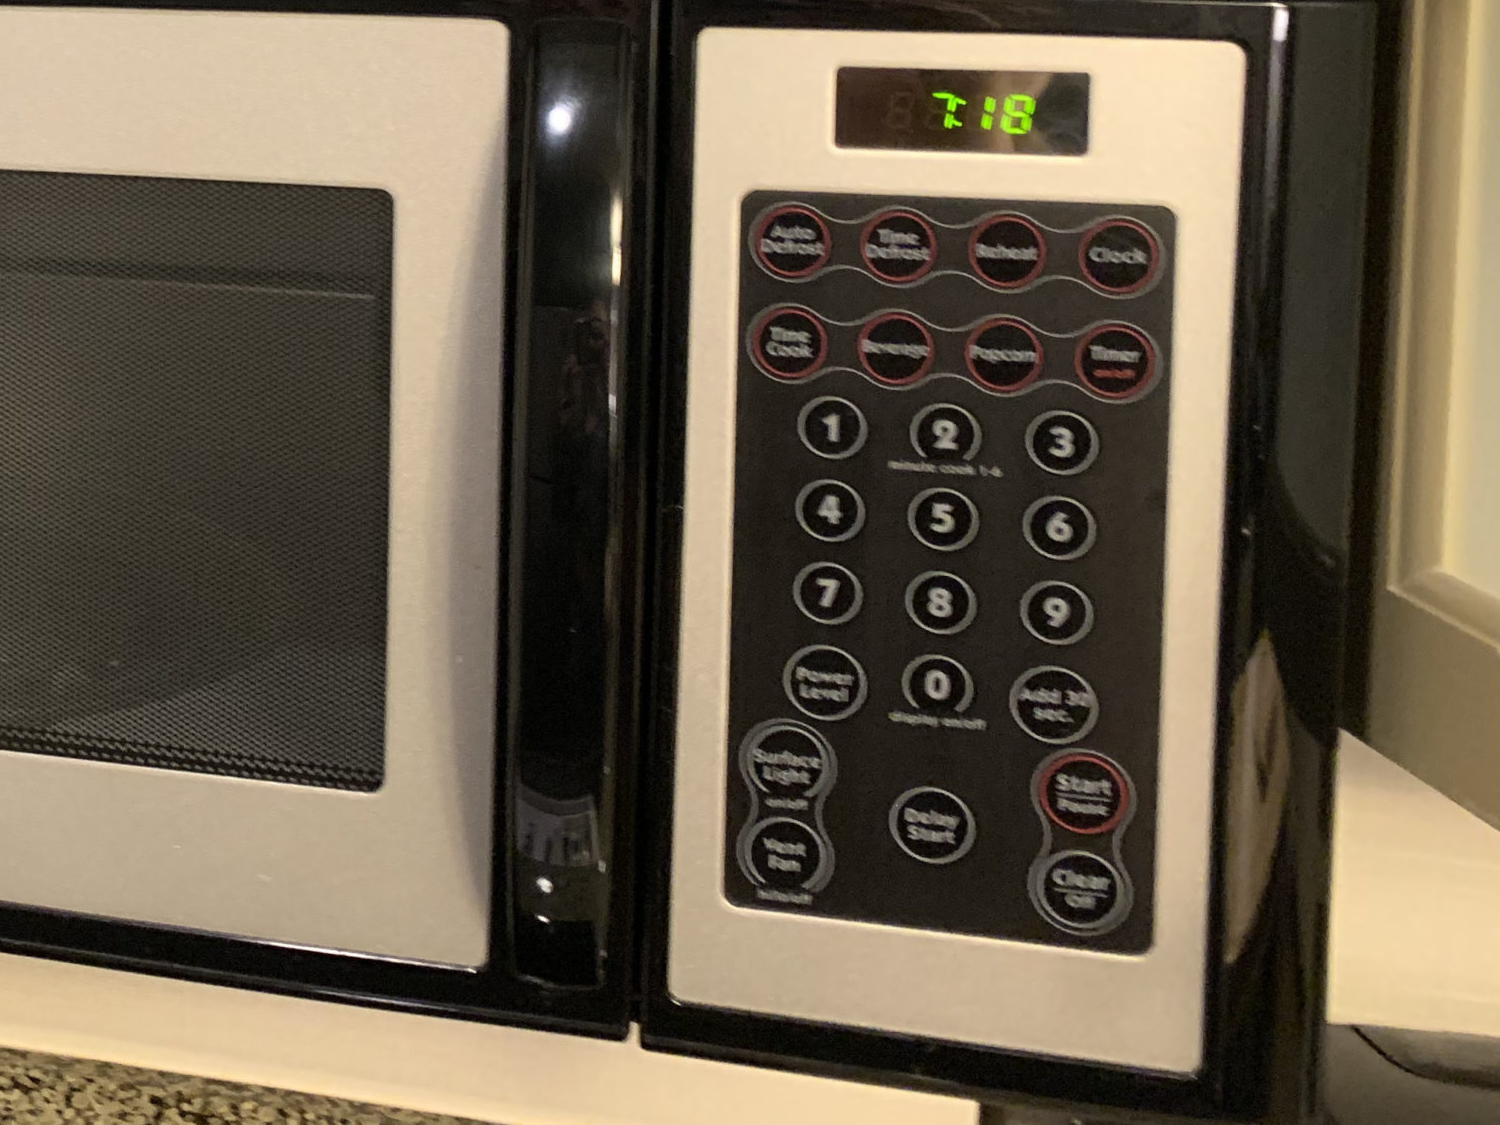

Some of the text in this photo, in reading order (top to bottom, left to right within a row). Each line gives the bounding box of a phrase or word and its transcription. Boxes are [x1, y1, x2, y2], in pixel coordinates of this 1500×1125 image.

[1088, 246, 1148, 264] Clock
[765, 341, 814, 358] Cook
[821, 413, 841, 442] 1
[931, 419, 959, 450] 2
[1048, 426, 1076, 457] 3
[816, 495, 843, 525] 4
[930, 503, 956, 534] 5
[1046, 511, 1073, 543] 6
[815, 578, 841, 608] 7
[927, 586, 954, 617] 8
[1044, 596, 1072, 628] 9
[795, 665, 855, 686] Power
[924, 669, 951, 701] 0
[799, 683, 849, 703] Level
[762, 765, 812, 786] Light
[1054, 773, 1112, 796] Start
[906, 824, 956, 845] Start
